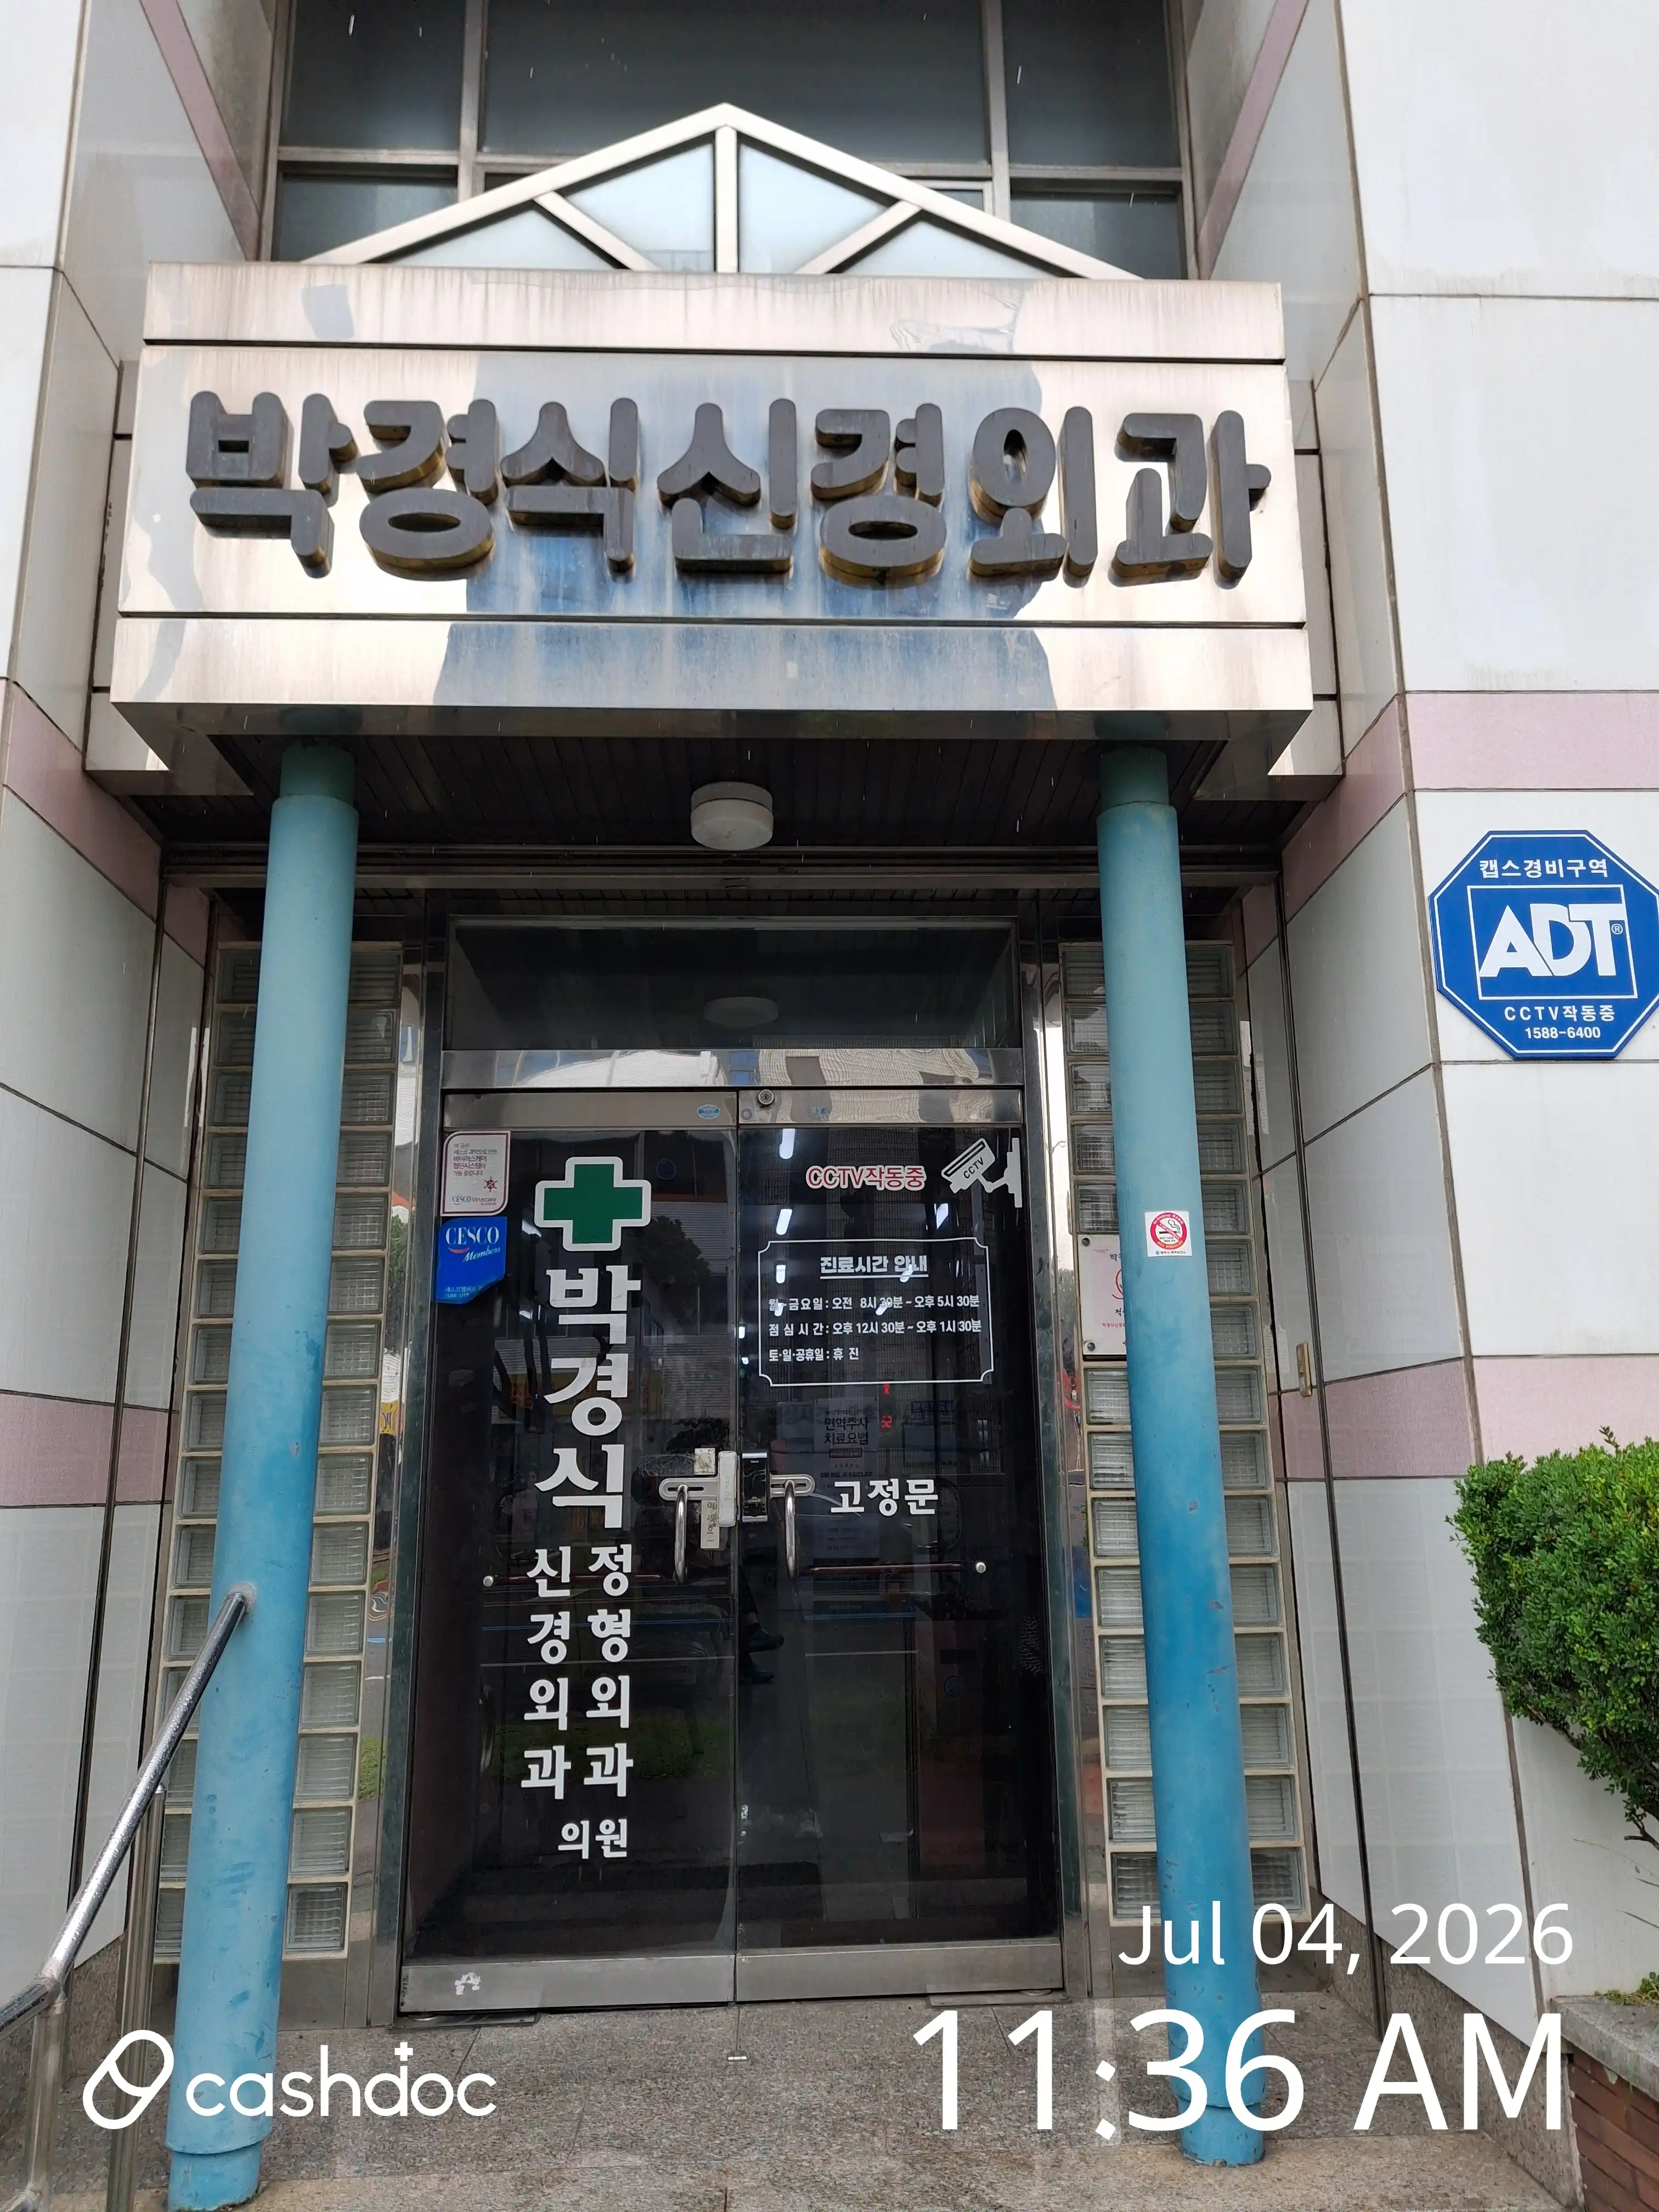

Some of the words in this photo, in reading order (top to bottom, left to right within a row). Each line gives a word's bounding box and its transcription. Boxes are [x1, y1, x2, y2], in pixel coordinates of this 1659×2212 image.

[185, 391, 1271, 586] 박경식신경외과
[1479, 859, 1609, 878] 캡스경비구역
[1525, 1026, 1601, 1039] 1588-6400
[962, 1156, 986, 1179] CCTV
[807, 1166, 926, 1190] CCTV작동중
[445, 1226, 499, 1245] CESCO
[462, 1245, 501, 1263] Members
[820, 1255, 889, 1274] 진료시간
[894, 1254, 928, 1273] 안내
[832, 1296, 853, 1310] 오전
[860, 1296, 877, 1309] 8시
[879, 1295, 903, 1309] 30분
[915, 1295, 935, 1308] 오후
[938, 1295, 954, 1308] 5시
[956, 1294, 980, 1307] 30분
[832, 1321, 853, 1335] 오후
[856, 1321, 878, 1334] 12시
[881, 1320, 905, 1334] 30분
[916, 1320, 936, 1334] 오후
[940, 1319, 956, 1333] 1시
[958, 1318, 982, 1333] 30분
[534, 1265, 641, 1528] 박경식
[824, 1416, 870, 1431] 면역주사
[824, 1432, 869, 1446] 치료요법
[831, 1478, 939, 1517] 고정문
[521, 1545, 572, 1799] 신경외과
[583, 1544, 634, 1798] 정형외과
[557, 1818, 628, 1860] 의원
